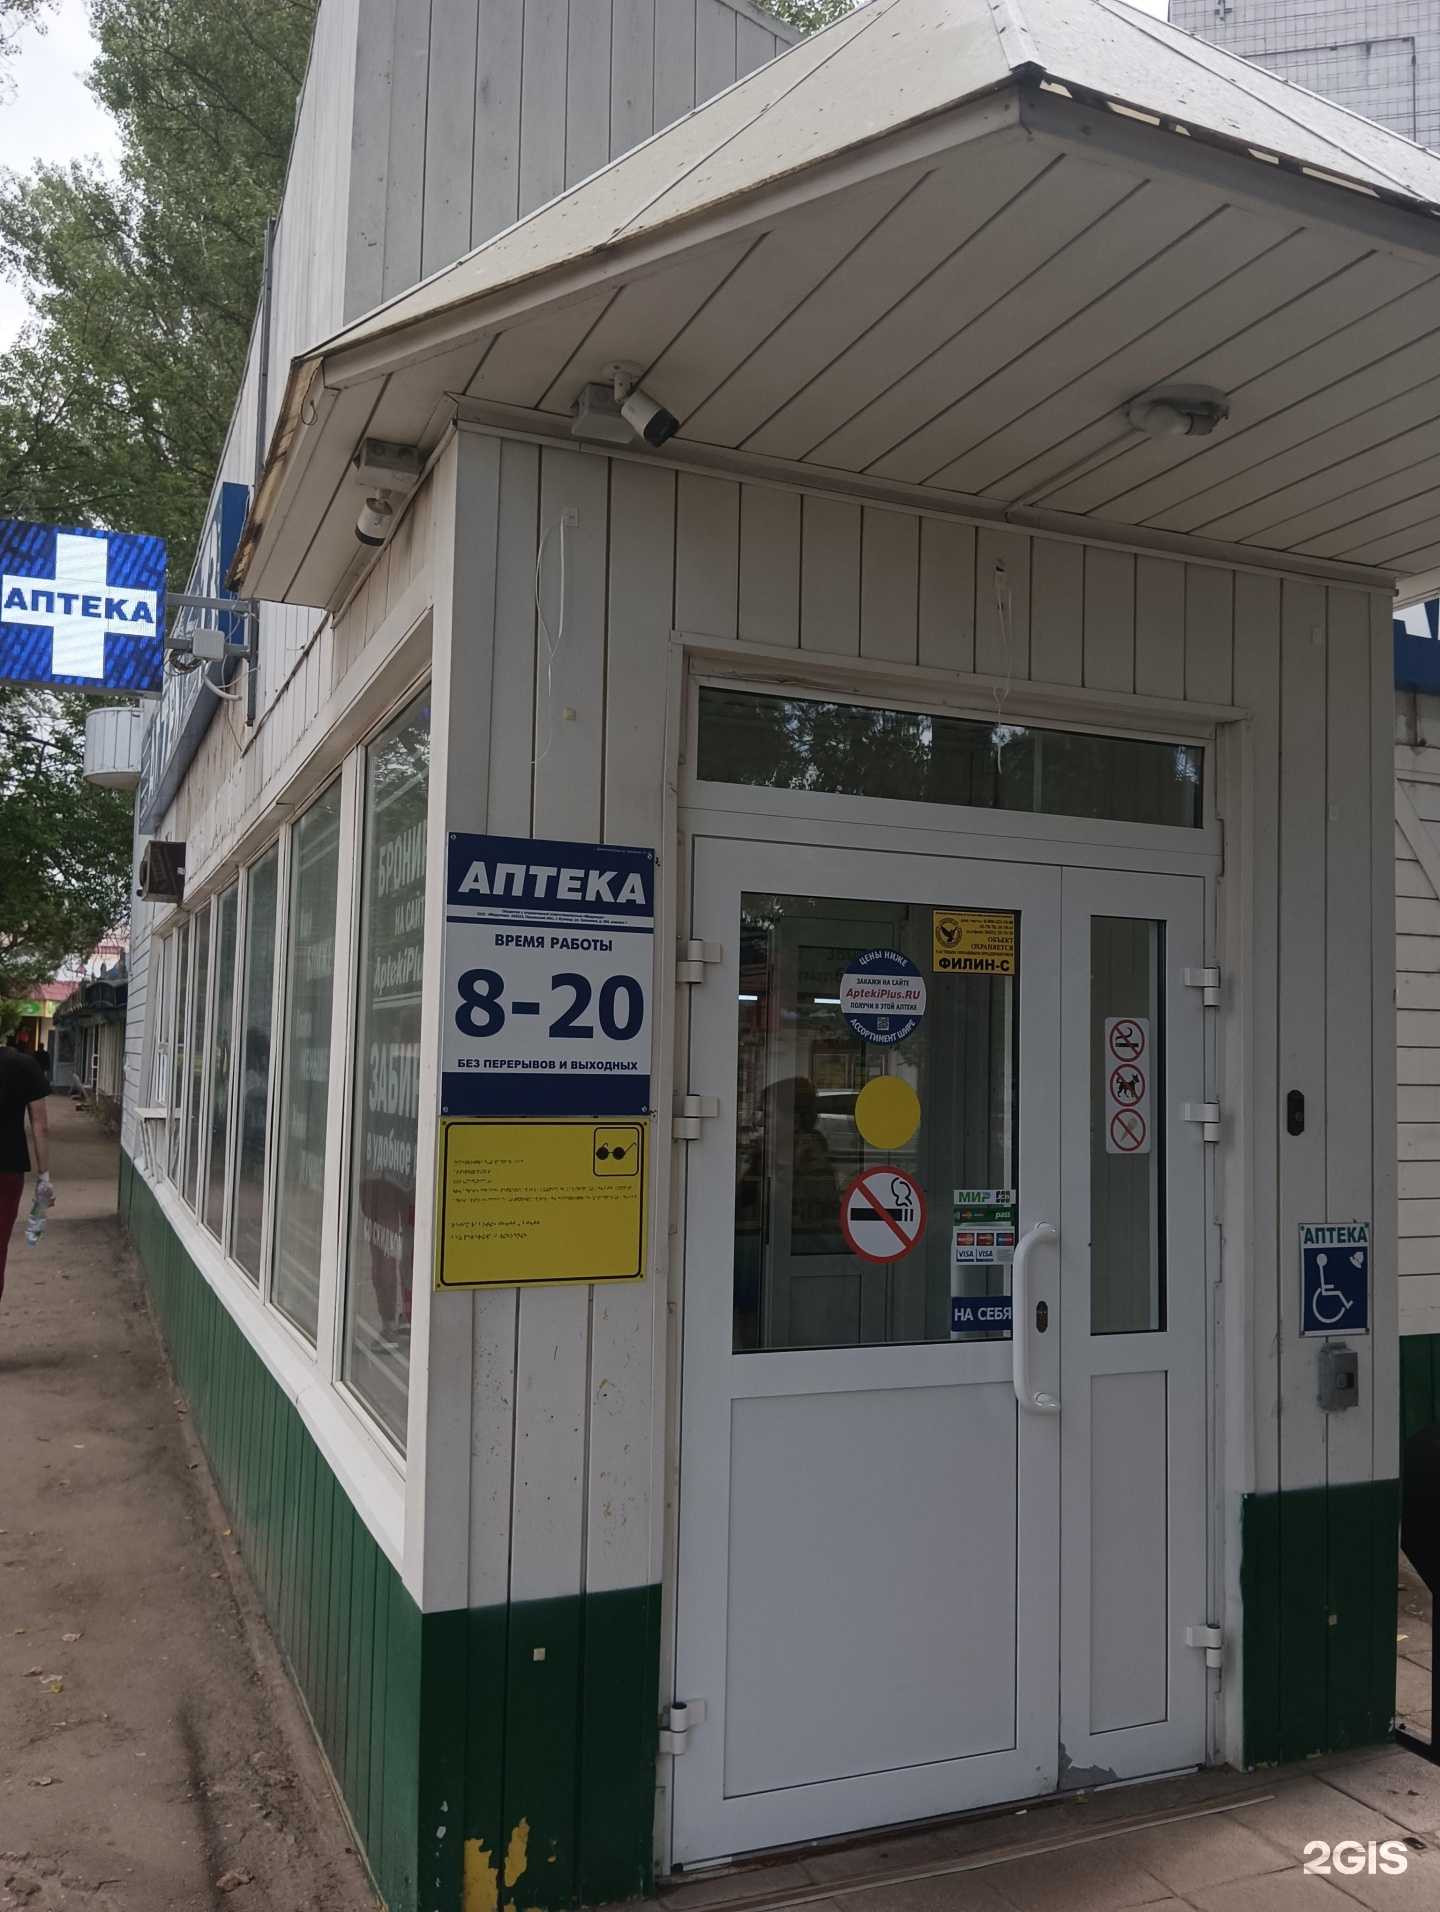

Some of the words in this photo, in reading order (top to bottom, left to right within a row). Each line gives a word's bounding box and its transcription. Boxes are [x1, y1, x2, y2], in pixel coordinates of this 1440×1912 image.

[4, 587, 154, 624] АПТЕКА
[457, 860, 646, 905] АПТЕКА
[494, 933, 545, 949] ВРЕМЯ
[550, 937, 613, 951] РАБОТЫ
[858, 951, 882, 966] ЦЕНЫ
[884, 951, 909, 967] НИЖЕ
[939, 957, 1010, 972] ФИЛИН-С
[846, 988, 921, 1000] AptekiPlus.RU
[455, 968, 644, 1041] 8-20
[850, 1018, 898, 1043] АССОРТИМЕНТ
[457, 1058, 481, 1069] БЕЗ
[483, 1059, 556, 1070] ПЕРЕРЫВОВ
[559, 1060, 568, 1070] И
[570, 1060, 638, 1071] ВЫХОДНЫХ
[1303, 1226, 1369, 1244] АПТЕКА
[958, 1250, 974, 1258] VISA
[954, 1307, 974, 1321] НА
[978, 1307, 1012, 1321] СЕБЯ
